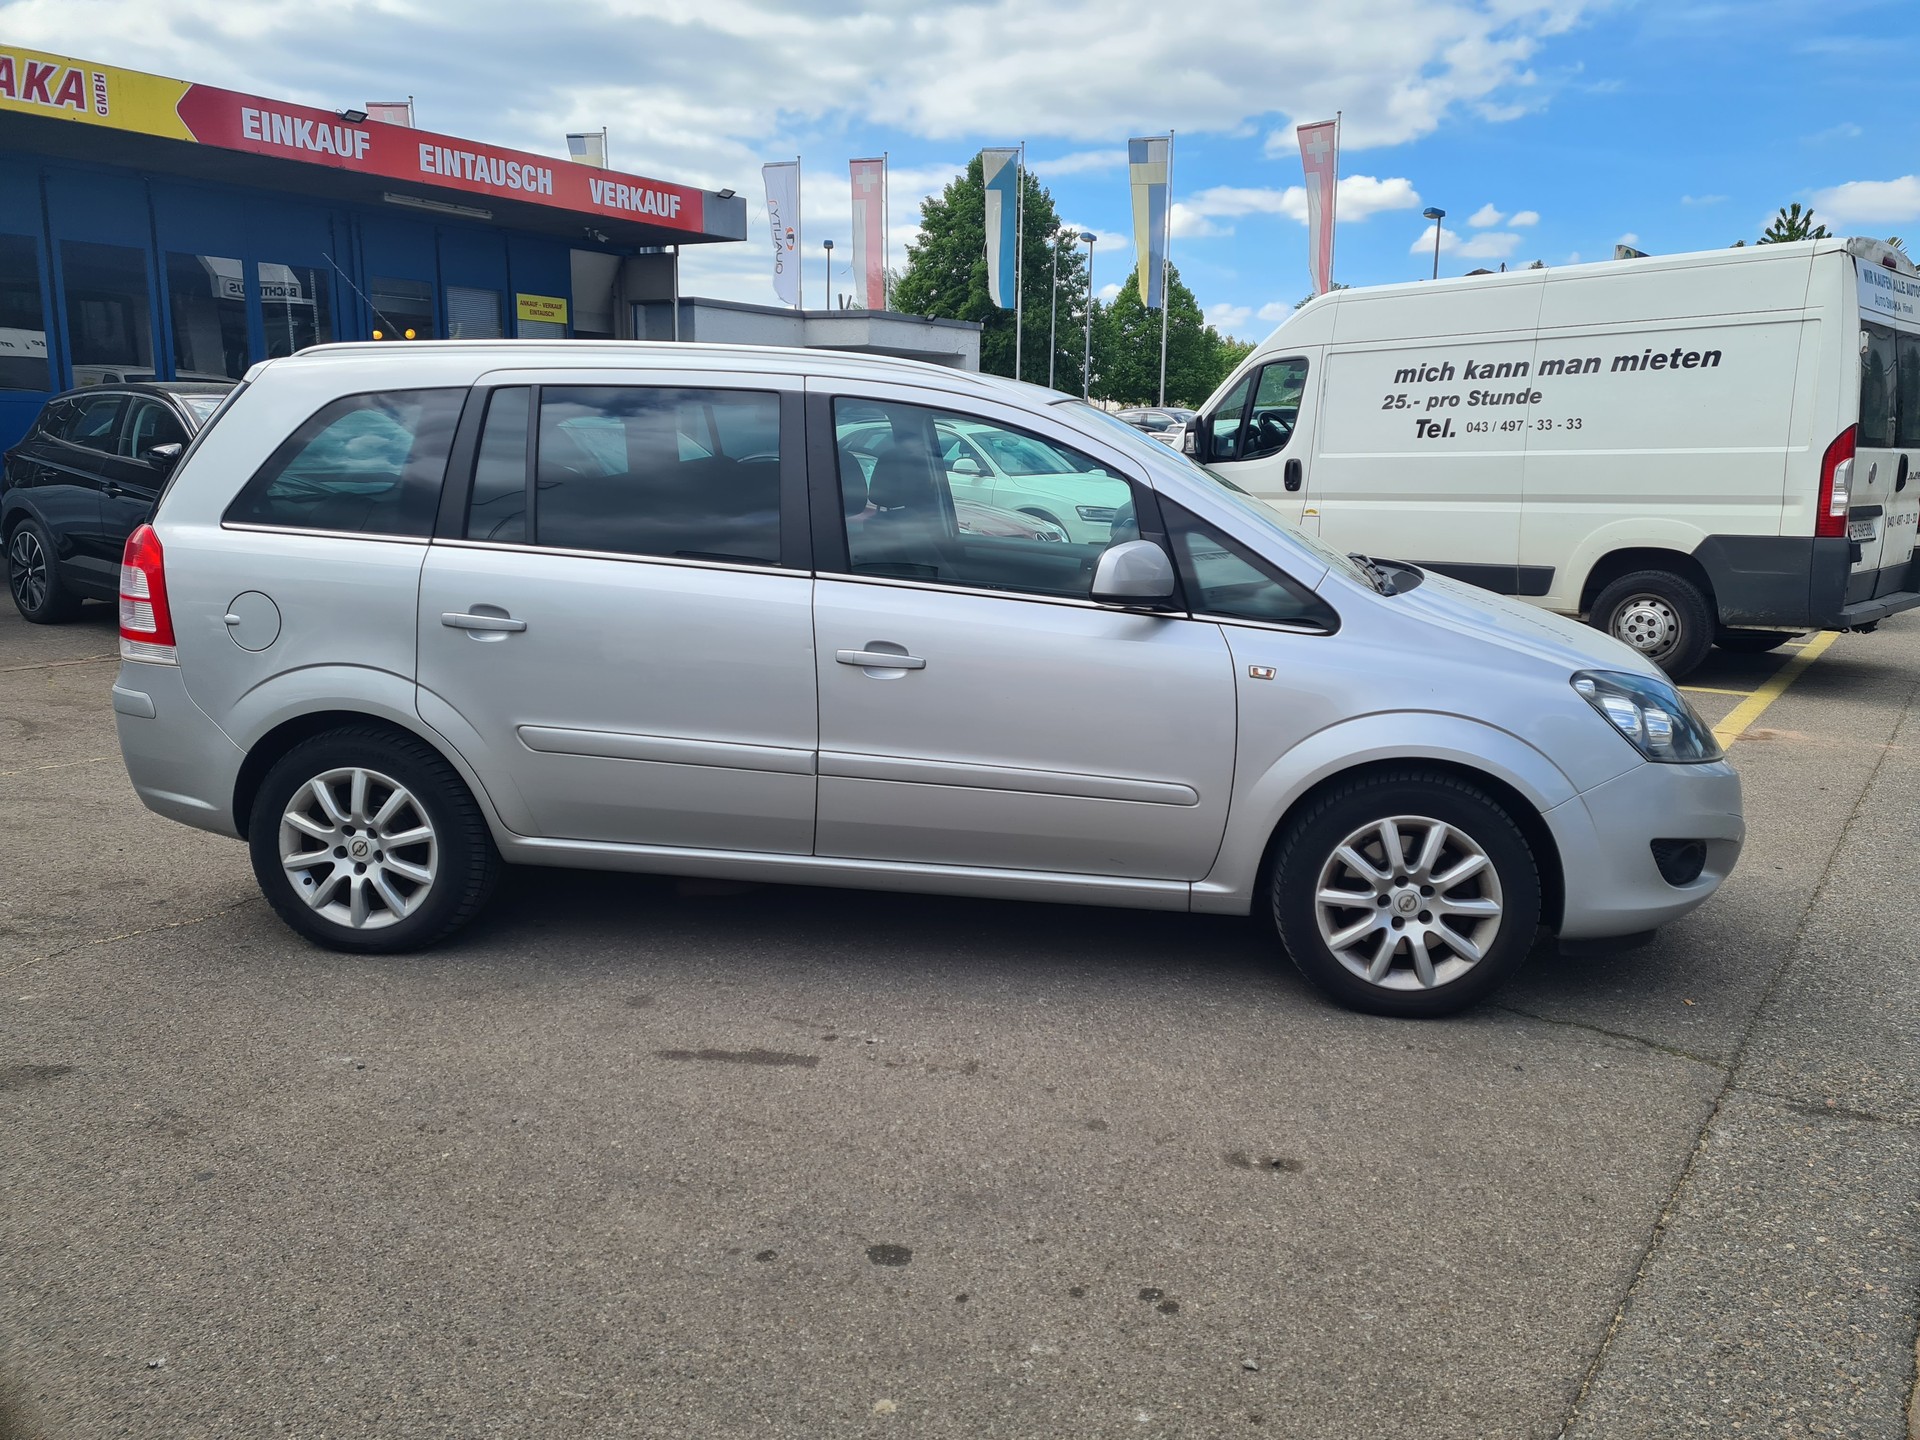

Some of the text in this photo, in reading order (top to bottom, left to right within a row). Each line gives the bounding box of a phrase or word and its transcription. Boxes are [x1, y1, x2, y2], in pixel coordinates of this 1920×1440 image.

[93, 73, 108, 115] GMBH
[241, 106, 371, 160] EINKAUF
[418, 142, 553, 196] EINTAUSCH
[588, 177, 681, 219] VERKAUF
[1893, 279, 1905, 294] ALLE
[520, 300, 538, 308] ANKAUF
[542, 302, 562, 310] VERKAUF
[530, 309, 555, 317] EINTAUSCH
[1394, 348, 1722, 384] mich kann man mieten
[1381, 388, 1543, 411] 25.- pro Stunde
[1416, 418, 1456, 439] Tel.
[1466, 421, 1489, 433] 043
[1500, 420, 1524, 431] 497
[1537, 419, 1553, 431] 33
[1566, 418, 1583, 430] 33
